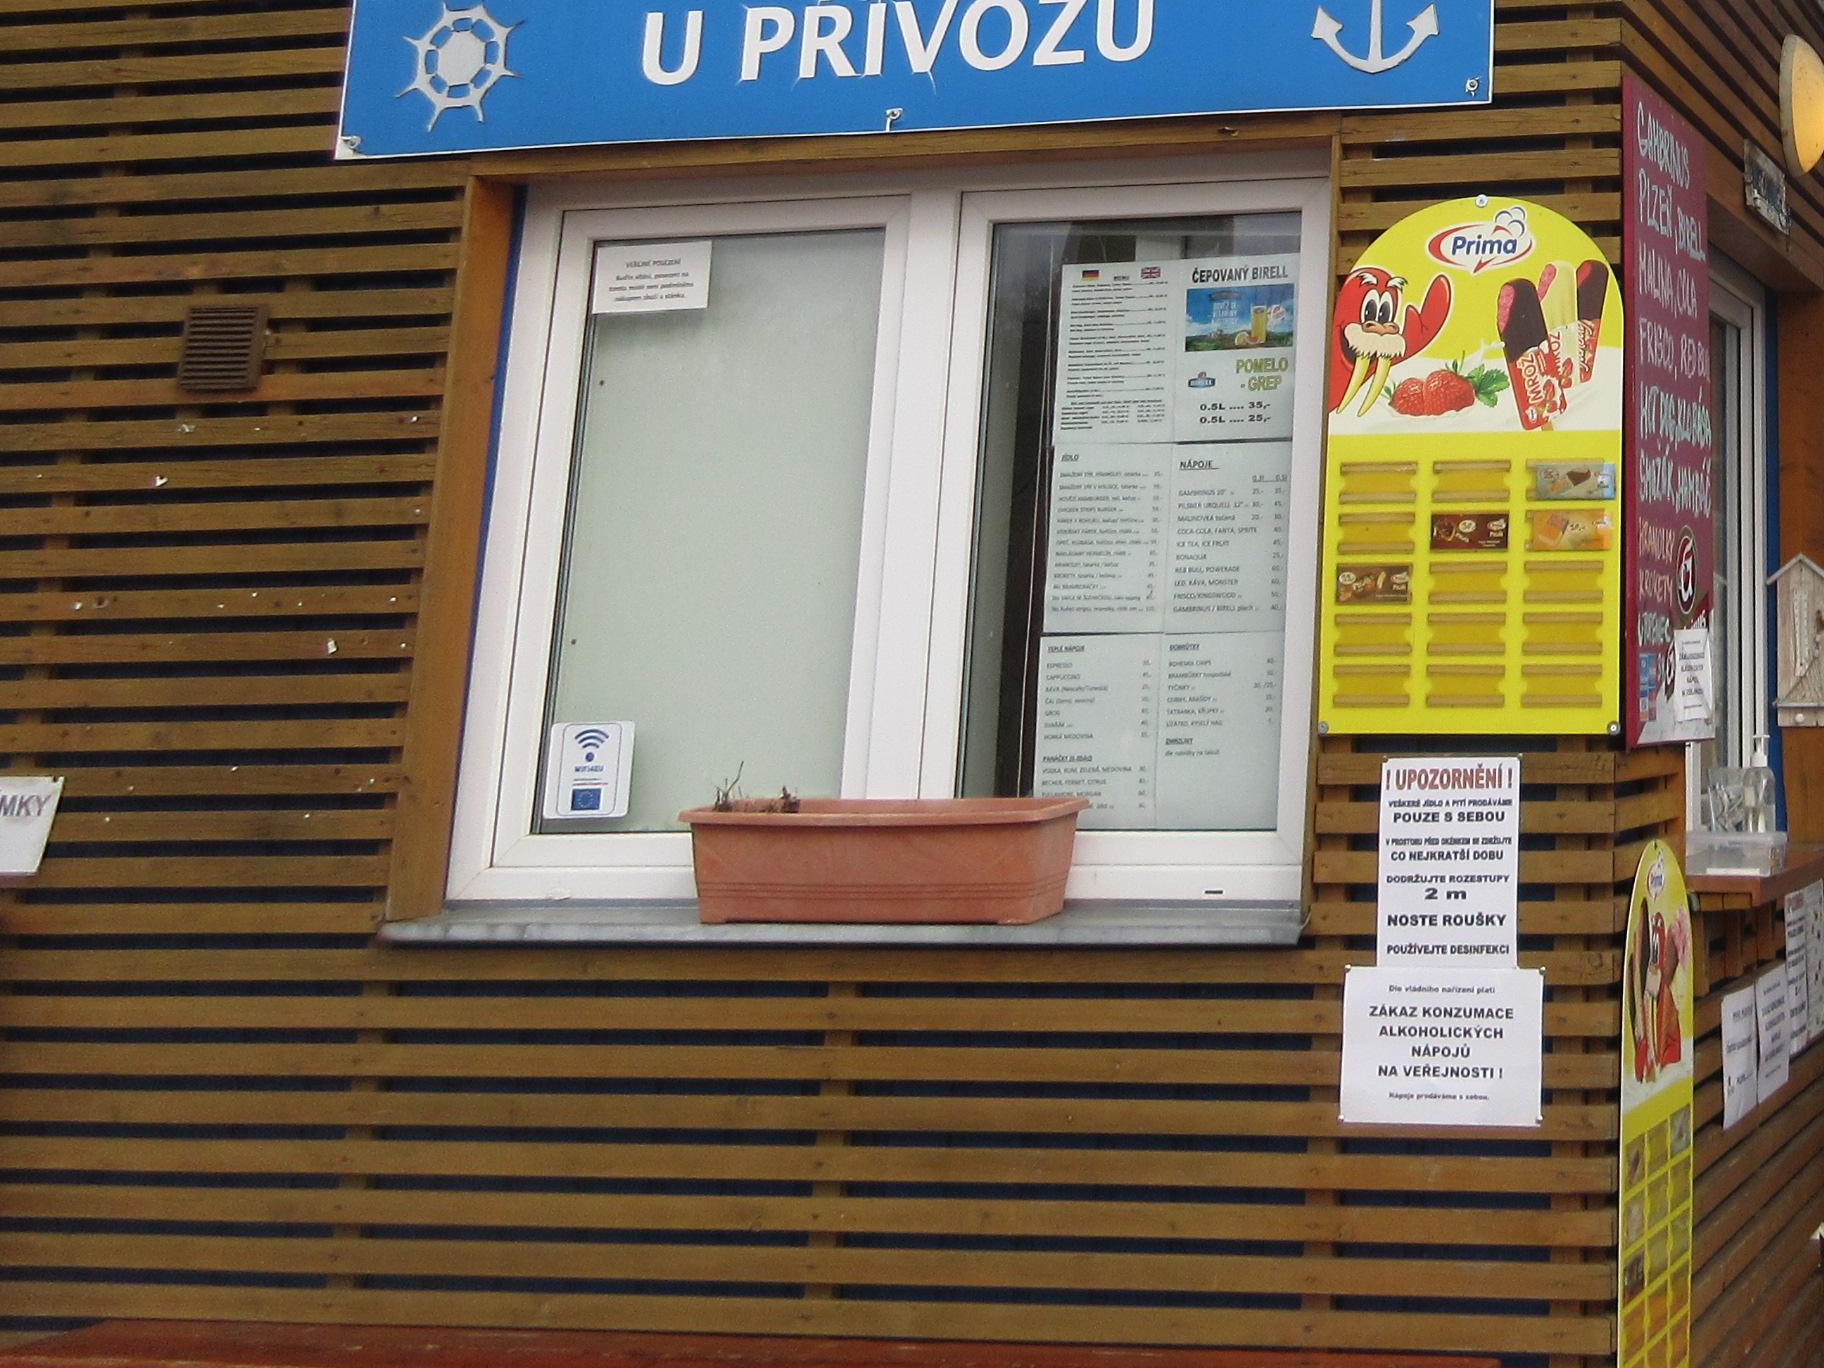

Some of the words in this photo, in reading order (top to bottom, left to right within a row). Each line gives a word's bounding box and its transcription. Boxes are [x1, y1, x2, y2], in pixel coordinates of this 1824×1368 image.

[641, 10, 704, 86] U
[1451, 234, 1518, 258] Prima
[1192, 266, 1249, 283] ČEPOVANÝ
[1252, 265, 1288, 280] BIRELL
[1236, 357, 1288, 374] POMELO
[1248, 375, 1282, 391] GREP
[1200, 403, 1226, 411] 0.5L
[1200, 416, 1226, 424] 0.5L
[1396, 763, 1502, 790] UPOZORNĚNÍ
[1393, 812, 1440, 823] POUZE
[1444, 812, 1453, 822] S
[1457, 811, 1505, 822] SEBOU
[1391, 851, 1406, 861] CO
[1409, 848, 1470, 861] NEJKRATŠÍ
[1473, 850, 1504, 860] DOBU
[1386, 874, 1446, 883] DODRŽUJTE
[1449, 874, 1509, 883] ROZESTUPY
[1424, 887, 1438, 900] 2
[1387, 914, 1437, 926] NOSTE
[1443, 912, 1506, 926] ROUŠKY
[1387, 943, 1447, 954] POUŽÍVEJTE
[1450, 944, 1509, 954] DESINFEKCI
[1369, 1004, 1418, 1017] ZÁKAZ
[1422, 1006, 1514, 1019] KONZUMACE
[1379, 1025, 1503, 1039] ALKOHOLICKÝCH
[1411, 1043, 1470, 1058] NÁPOJŮ
[1378, 1065, 1398, 1077] NA
[1403, 1063, 1494, 1079] VEŘEJNOSTI
